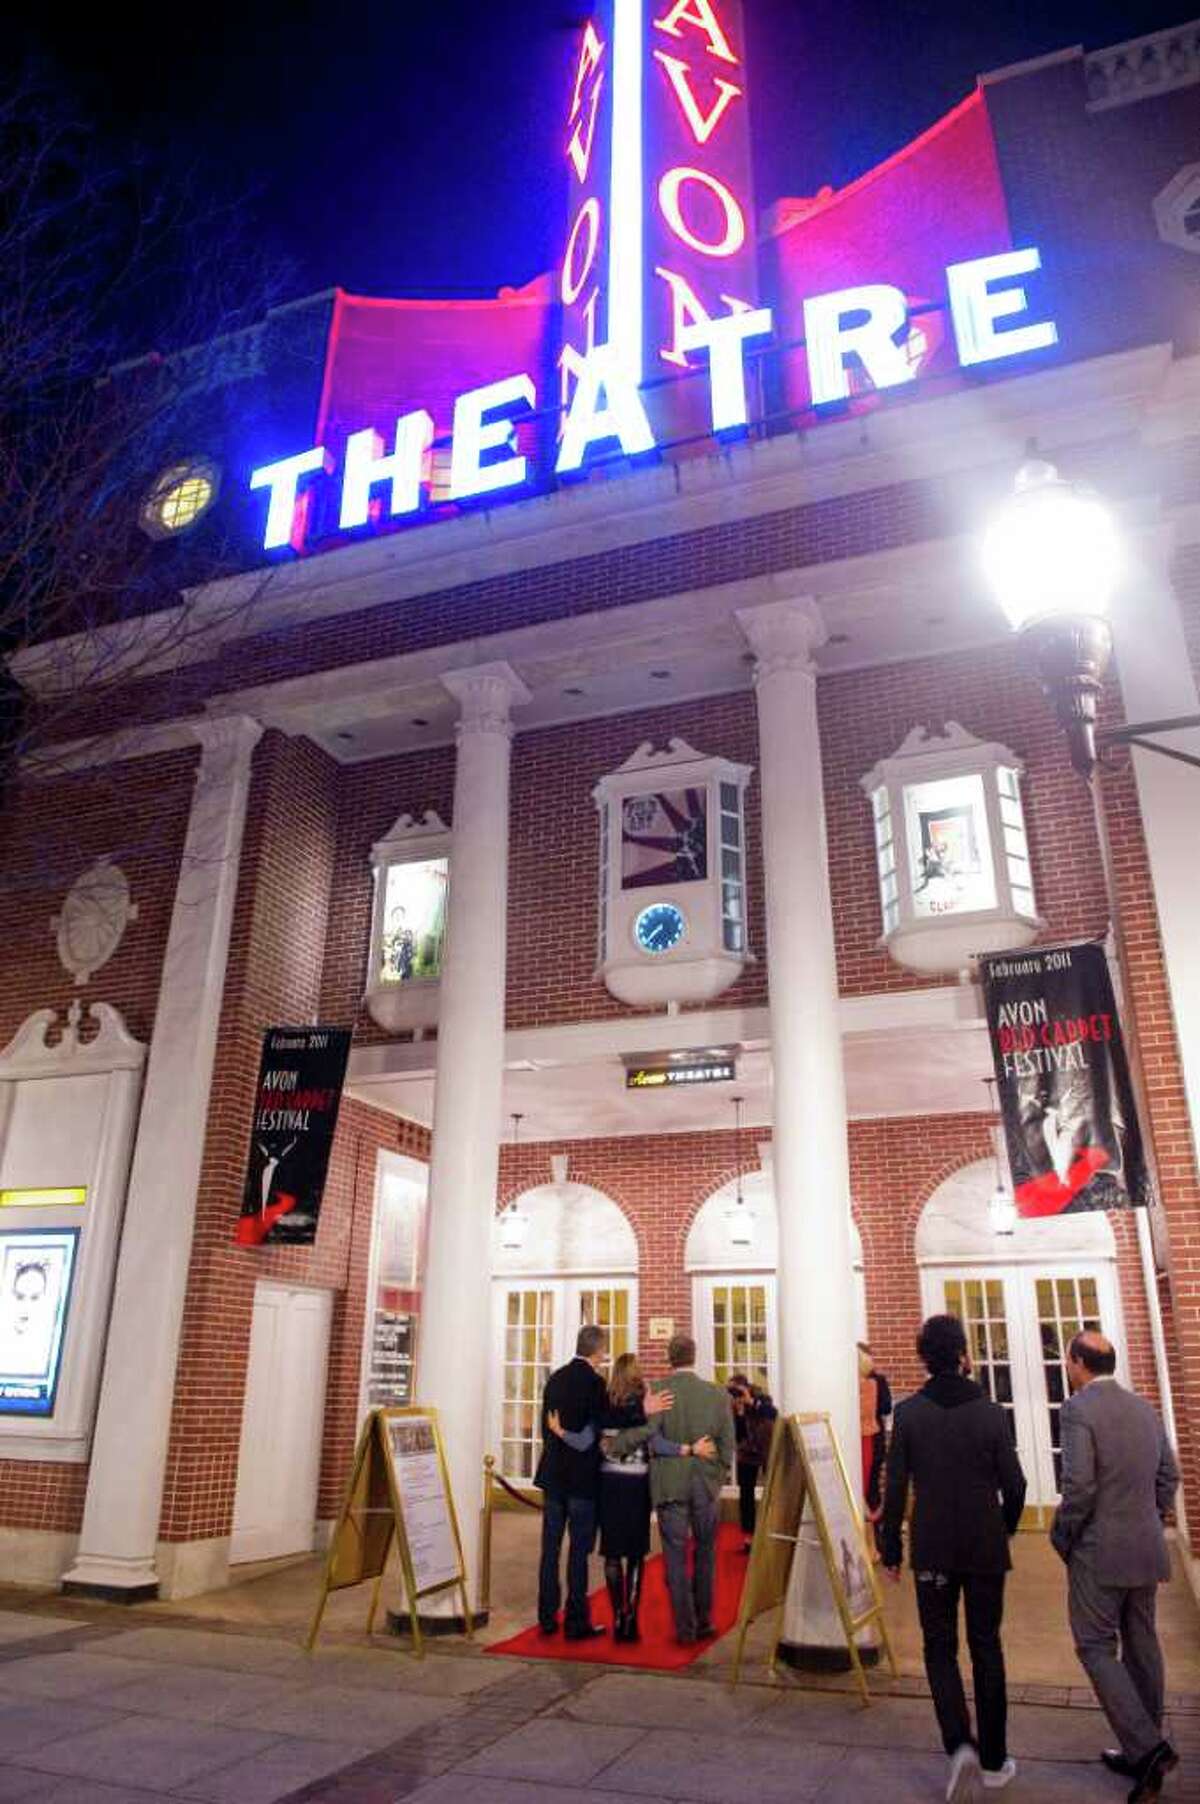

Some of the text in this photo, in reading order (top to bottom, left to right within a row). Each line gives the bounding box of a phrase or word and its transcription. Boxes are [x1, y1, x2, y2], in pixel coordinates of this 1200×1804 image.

[653, 0, 754, 370] AVON
[250, 247, 1059, 553] THEATRE
[1045, 951, 1072, 971] 2011
[999, 997, 1048, 1028] AVON
[1003, 1041, 1090, 1078] FESTIVAL
[262, 1070, 298, 1091] AVON
